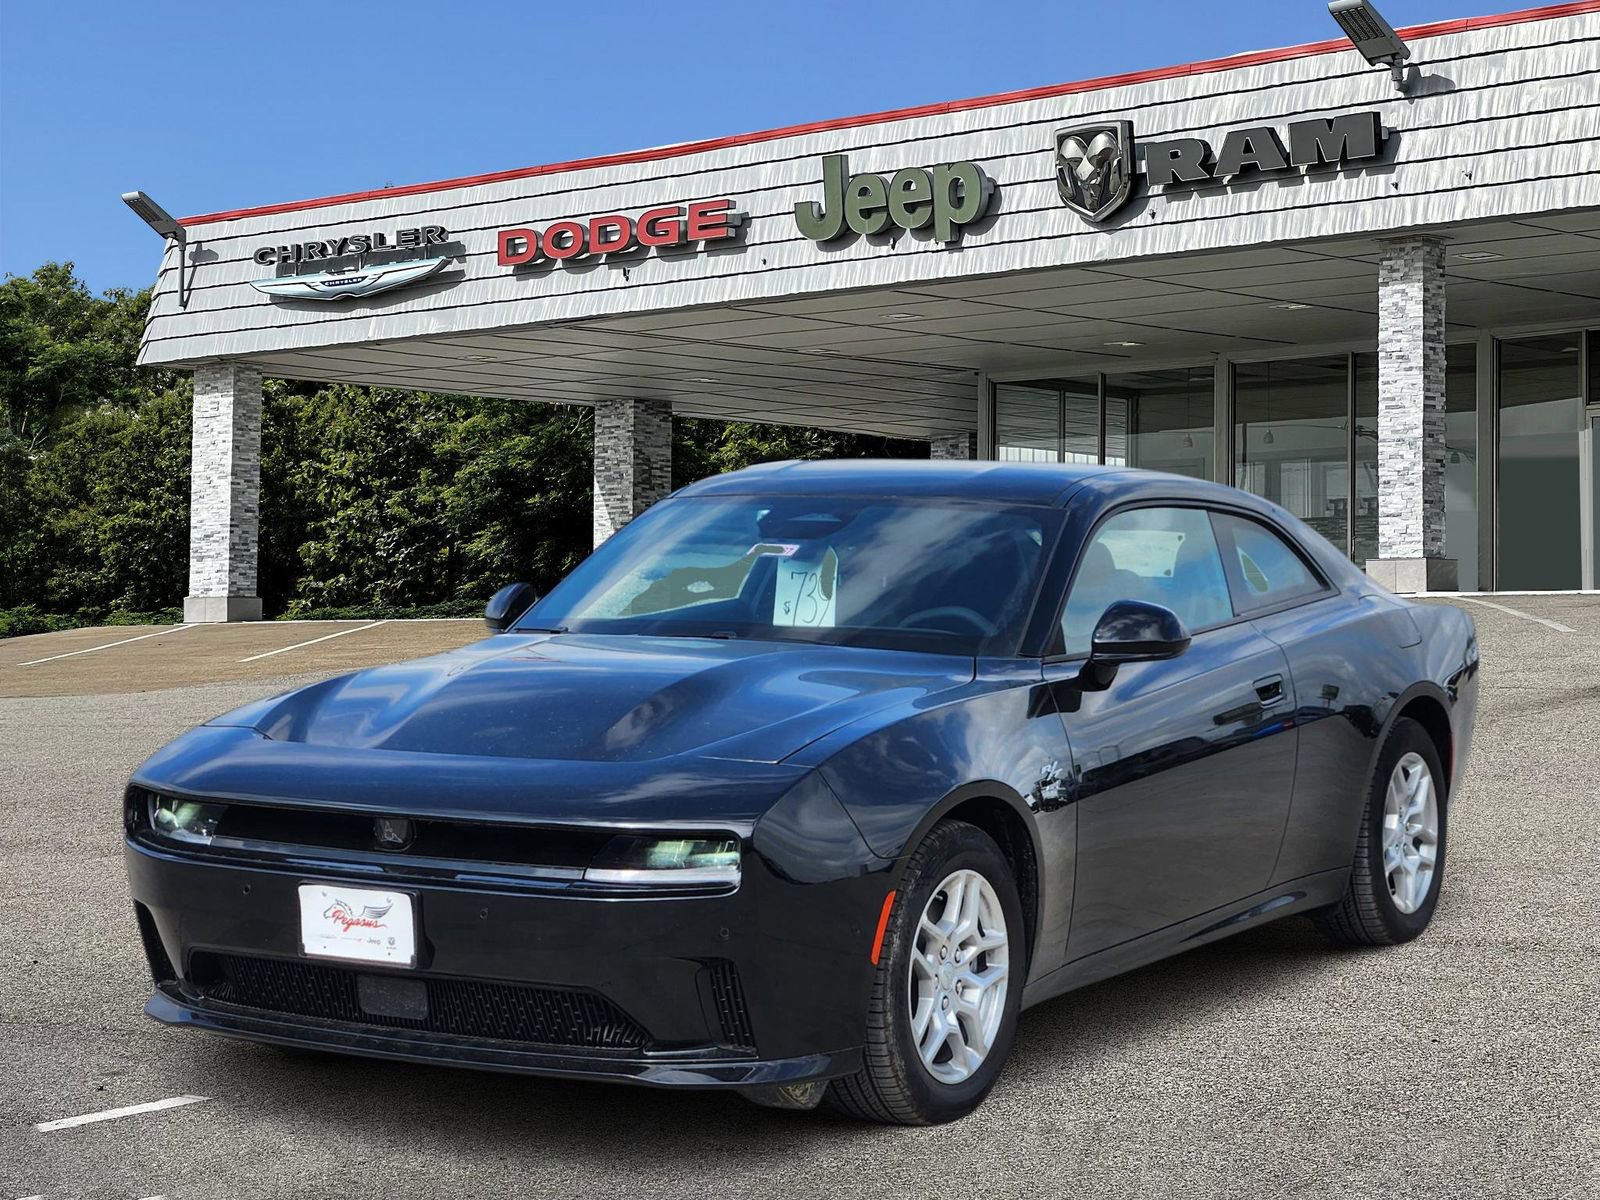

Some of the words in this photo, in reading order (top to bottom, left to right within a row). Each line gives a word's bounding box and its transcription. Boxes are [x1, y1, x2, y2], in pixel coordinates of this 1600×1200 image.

[1146, 111, 1382, 186] RAM
[794, 154, 983, 243] Jeep
[253, 224, 448, 266] CHRYSLER
[497, 199, 735, 266] DODGE
[324, 278, 363, 286] CHRYSLER
[331, 909, 388, 932] Pegasus
